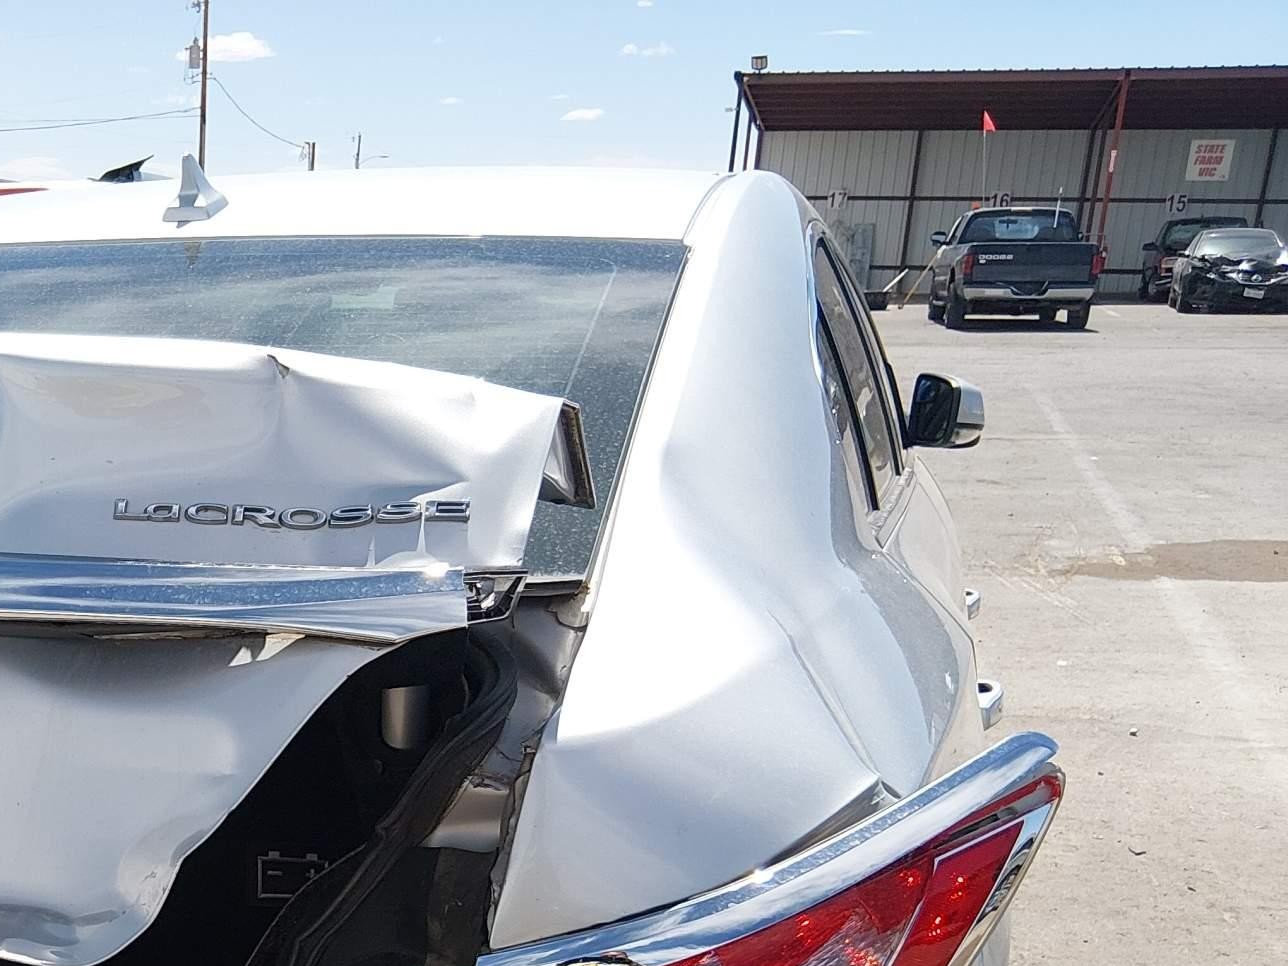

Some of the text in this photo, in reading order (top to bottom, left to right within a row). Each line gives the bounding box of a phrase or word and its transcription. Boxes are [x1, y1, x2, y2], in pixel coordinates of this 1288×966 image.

[1195, 144, 1227, 154] STATE
[1193, 155, 1224, 166] FARM
[1198, 167, 1217, 177] VIC
[828, 192, 847, 208] 17
[990, 193, 1010, 207] 16
[1167, 195, 1187, 212] 15
